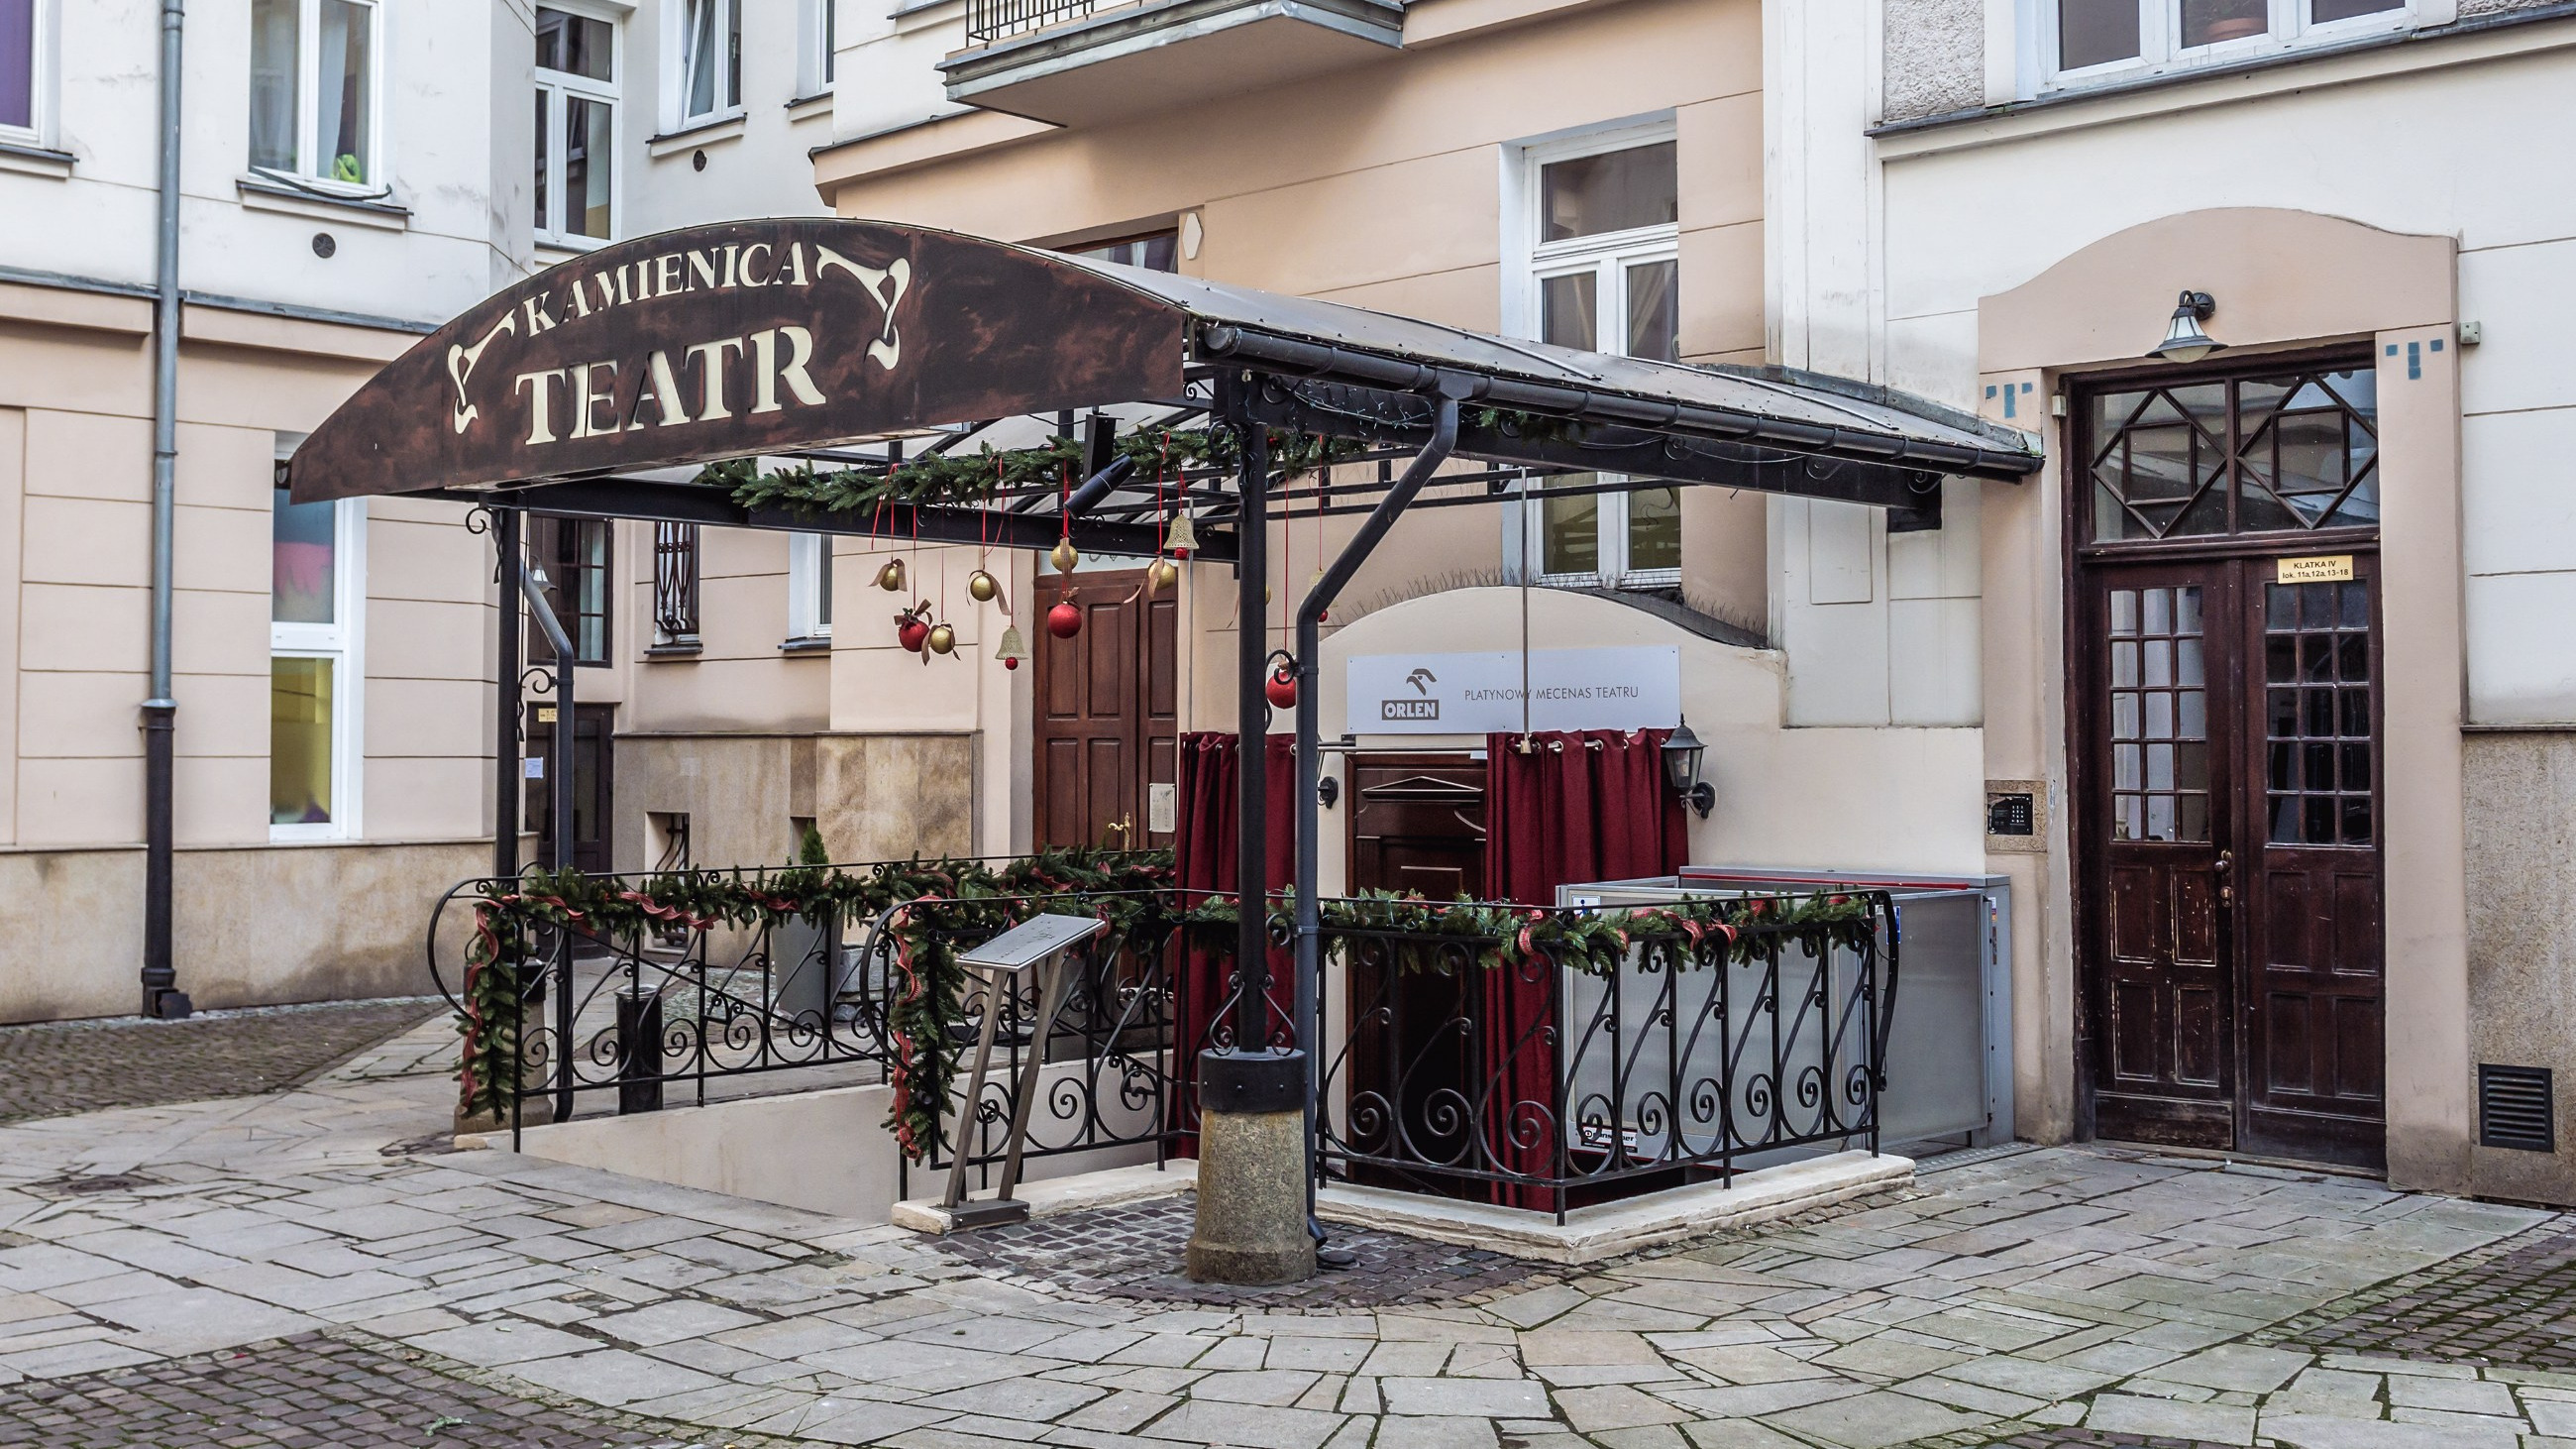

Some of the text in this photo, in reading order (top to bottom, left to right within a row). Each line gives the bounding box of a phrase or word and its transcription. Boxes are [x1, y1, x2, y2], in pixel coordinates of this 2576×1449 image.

[522, 241, 810, 338] KAMIENICA
[513, 325, 827, 446] TEATR
[1384, 702, 1436, 718] ORLEN
[1536, 687, 1592, 700] MECENAS
[1595, 686, 1639, 699] TEATRU
